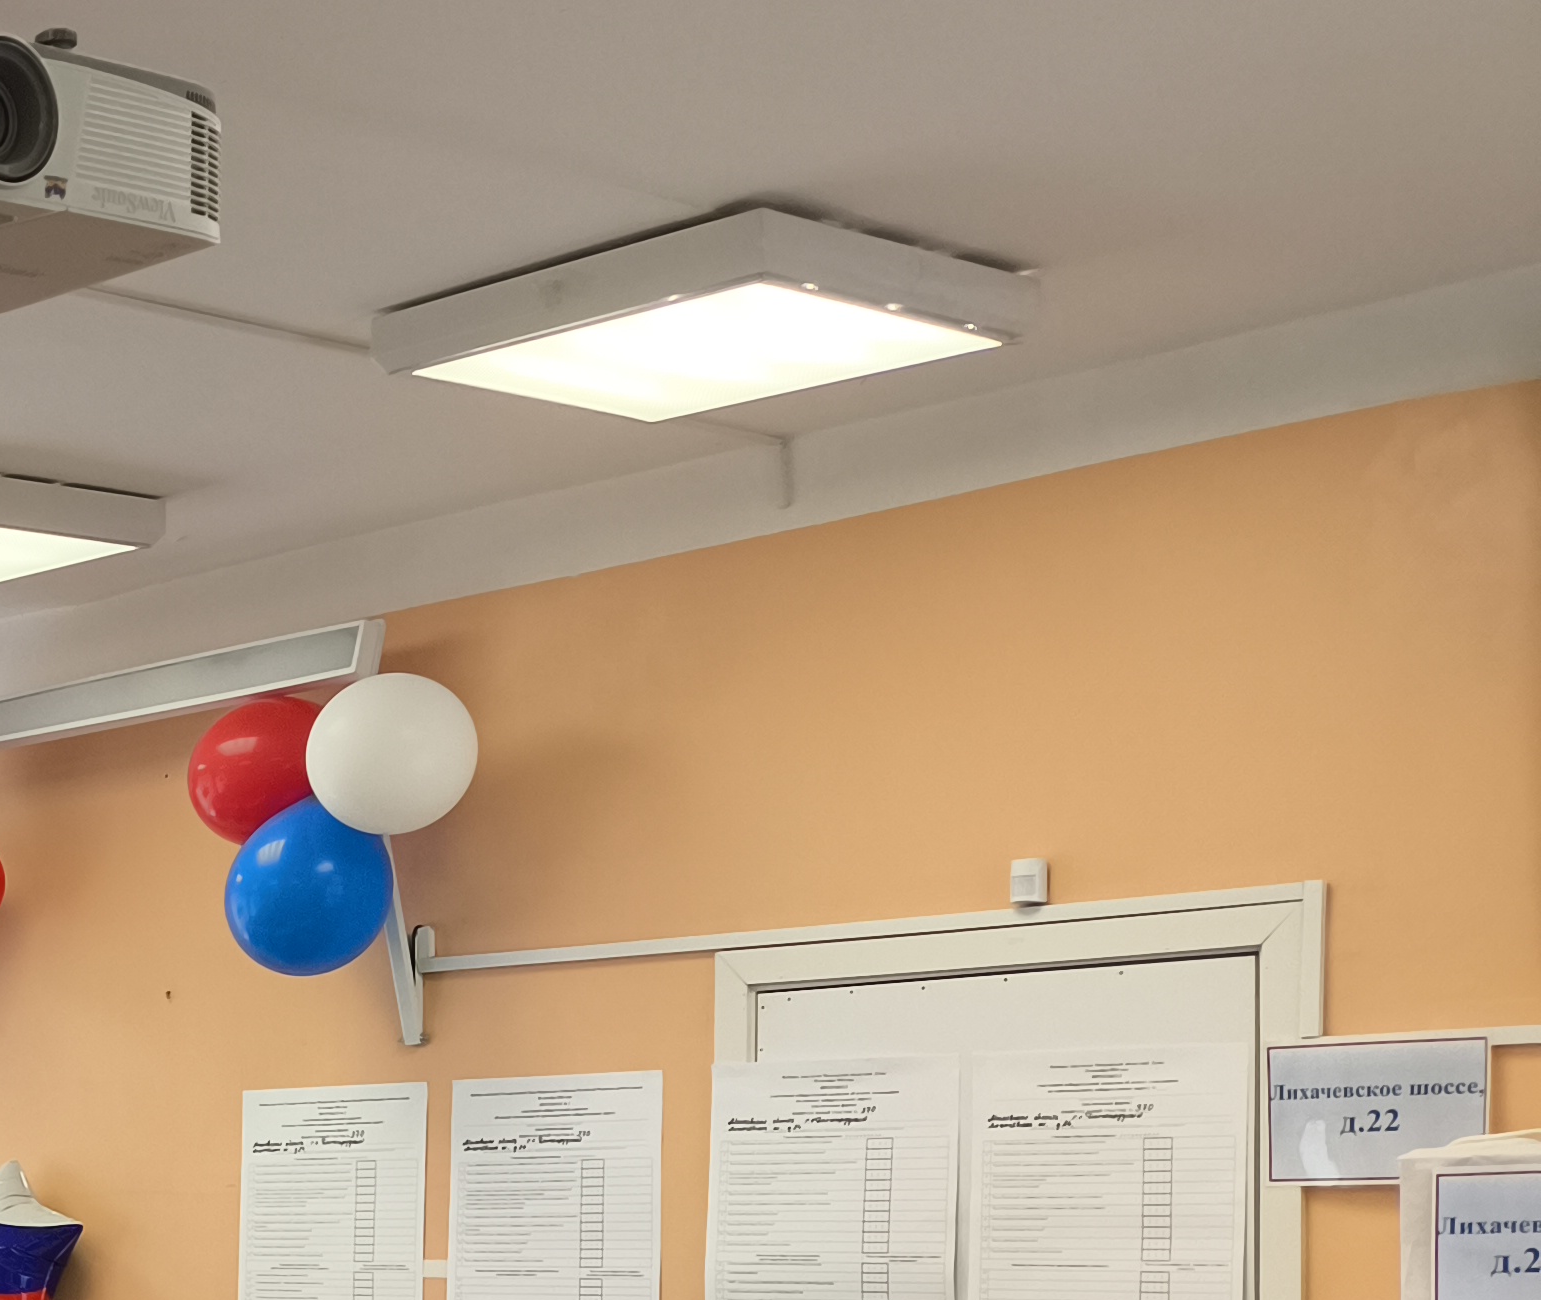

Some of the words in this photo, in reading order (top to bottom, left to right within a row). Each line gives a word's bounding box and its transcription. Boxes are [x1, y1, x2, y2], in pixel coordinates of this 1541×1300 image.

[1271, 1082, 1403, 1101] Лихачевское
[1409, 1080, 1486, 1098] шоссе,
[1340, 1108, 1402, 1136] д.22
[1490, 1247, 1541, 1277] д.2
